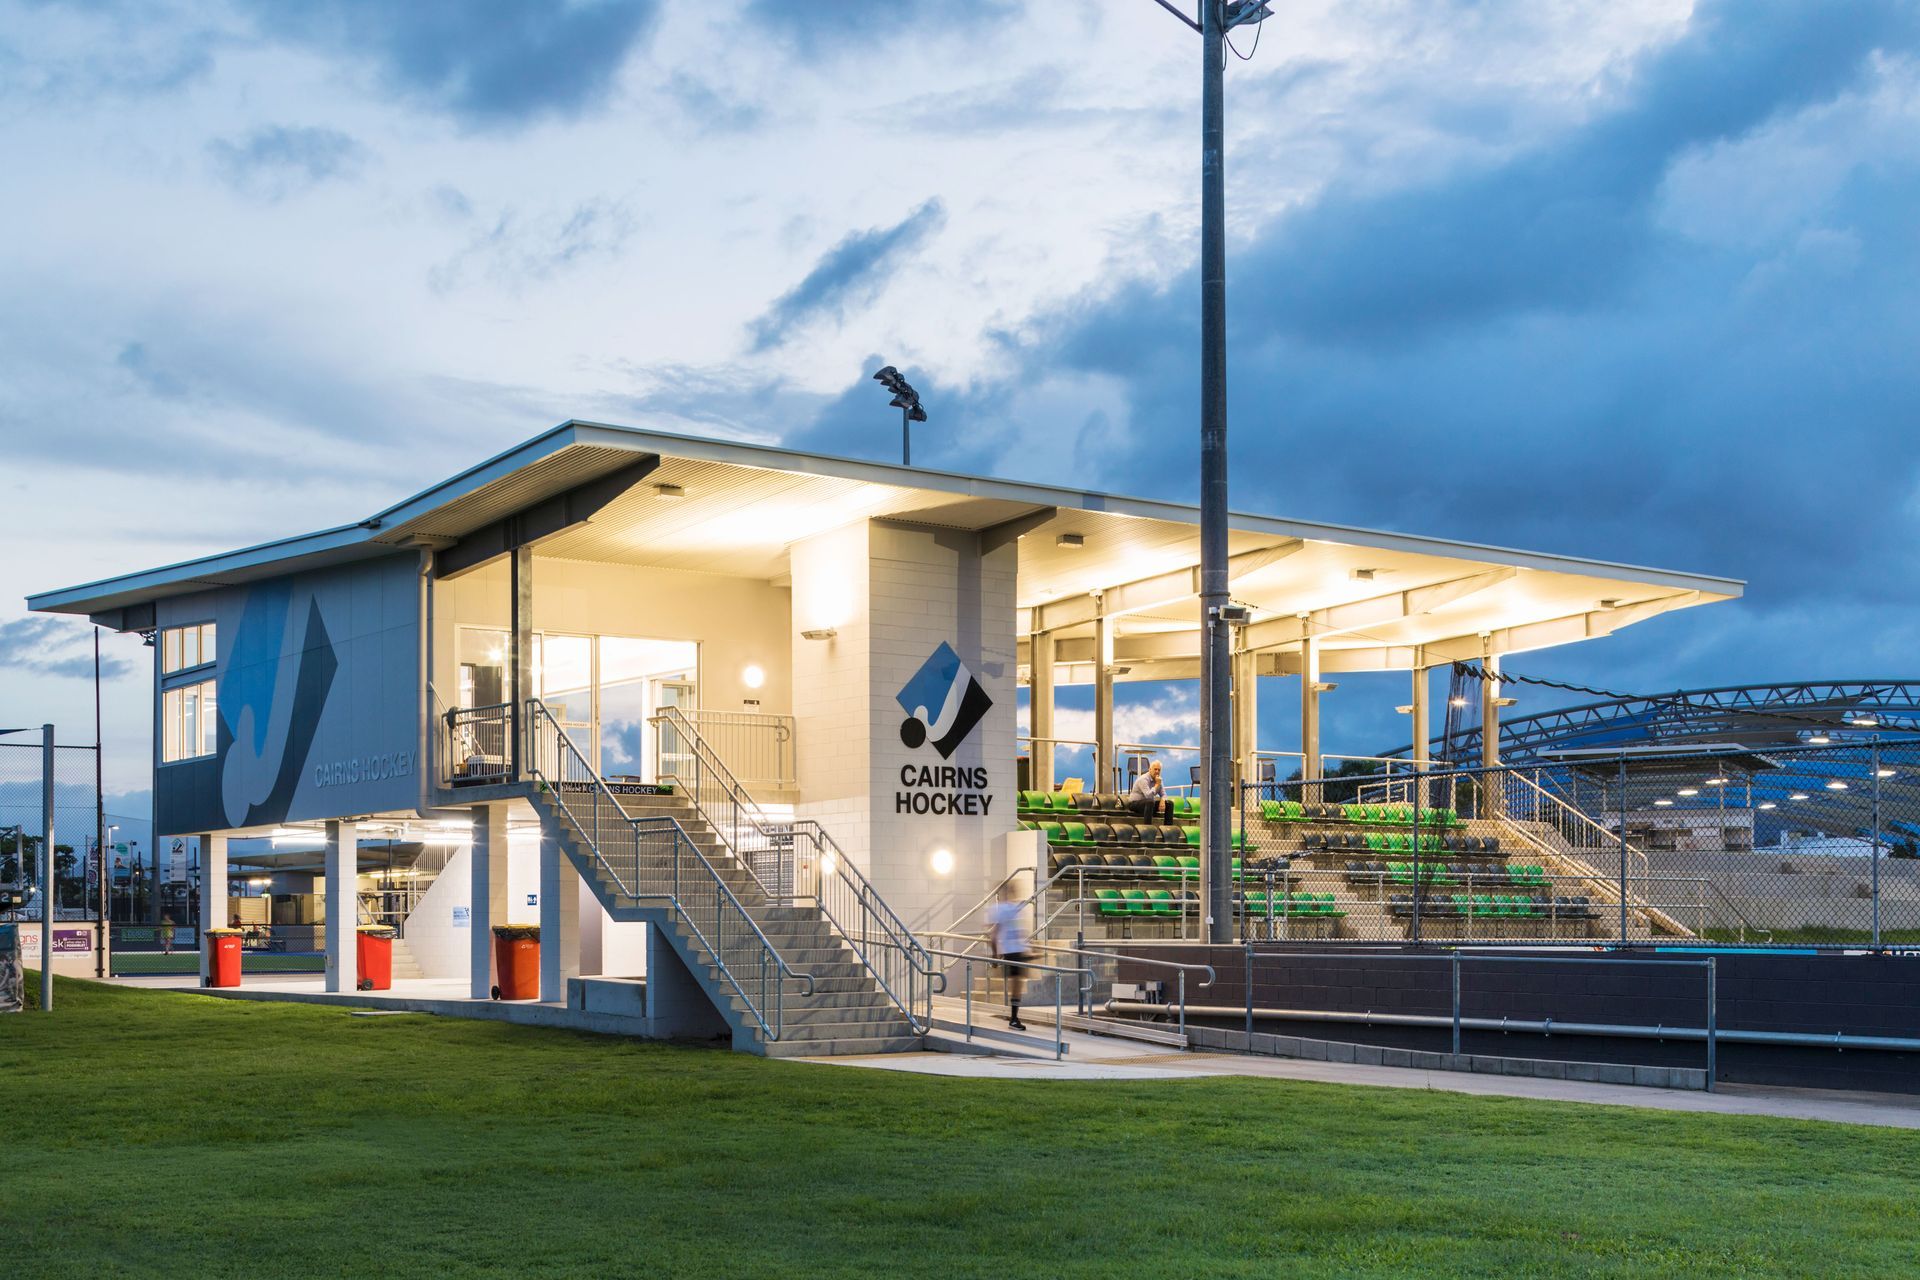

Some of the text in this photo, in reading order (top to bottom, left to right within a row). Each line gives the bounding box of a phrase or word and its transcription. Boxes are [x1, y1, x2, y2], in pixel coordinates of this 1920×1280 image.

[315, 750, 416, 788] CAIRNS HOCKEY
[901, 764, 988, 789] CAIRNS
[622, 785, 658, 795] HOCKEY
[896, 792, 993, 816] HOCKEY
[19, 934, 39, 945] gns
[52, 938, 64, 948] sk
